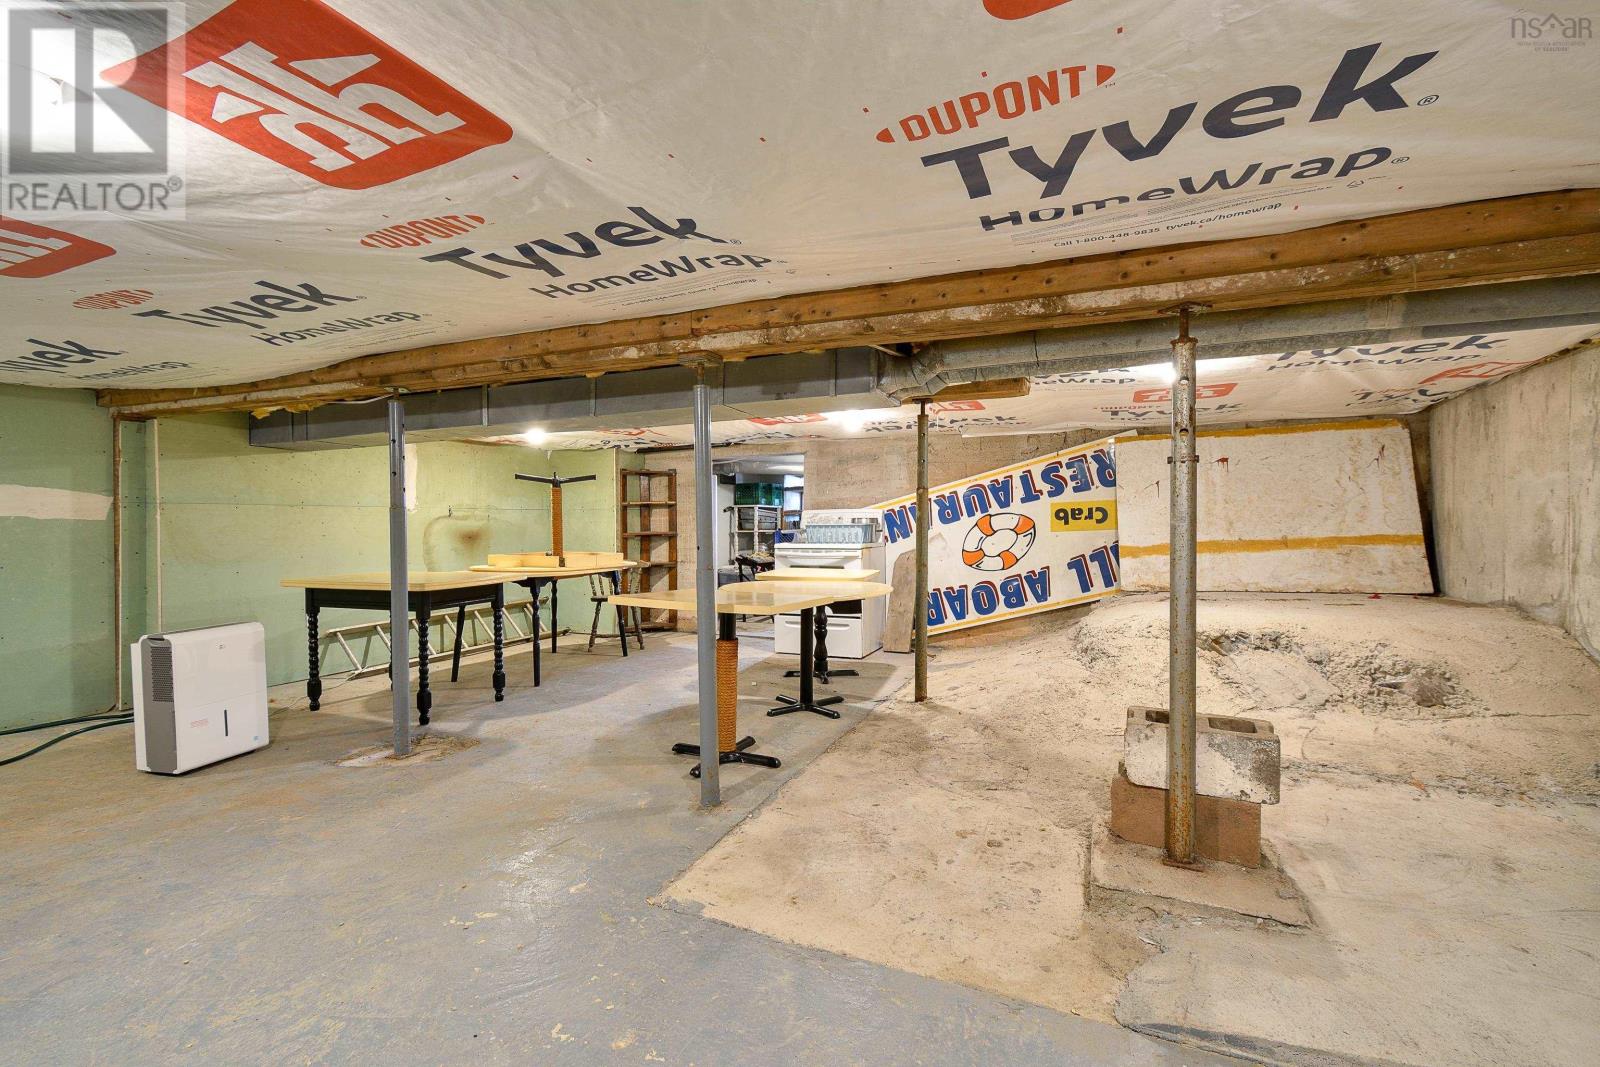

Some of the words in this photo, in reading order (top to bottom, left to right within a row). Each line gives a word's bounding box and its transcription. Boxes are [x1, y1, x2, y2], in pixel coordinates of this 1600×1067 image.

[899, 65, 1087, 142] DUPONT
[921, 42, 1439, 199] Tyvek
[979, 147, 1393, 232] HomeWrap
[365, 215, 478, 248] DUPONT
[1166, 202, 1282, 230] tyvek.ca/homewrap
[420, 207, 729, 279] Tyvek
[528, 251, 772, 299] HomeWrap
[132, 280, 358, 330] Tyvek
[250, 311, 422, 347] HomeWrap
[0, 338, 122, 374] yvek
[883, 449, 1117, 543] RESTAURN
[1054, 506, 1109, 525] Crab
[1067, 540, 1120, 594] LL
